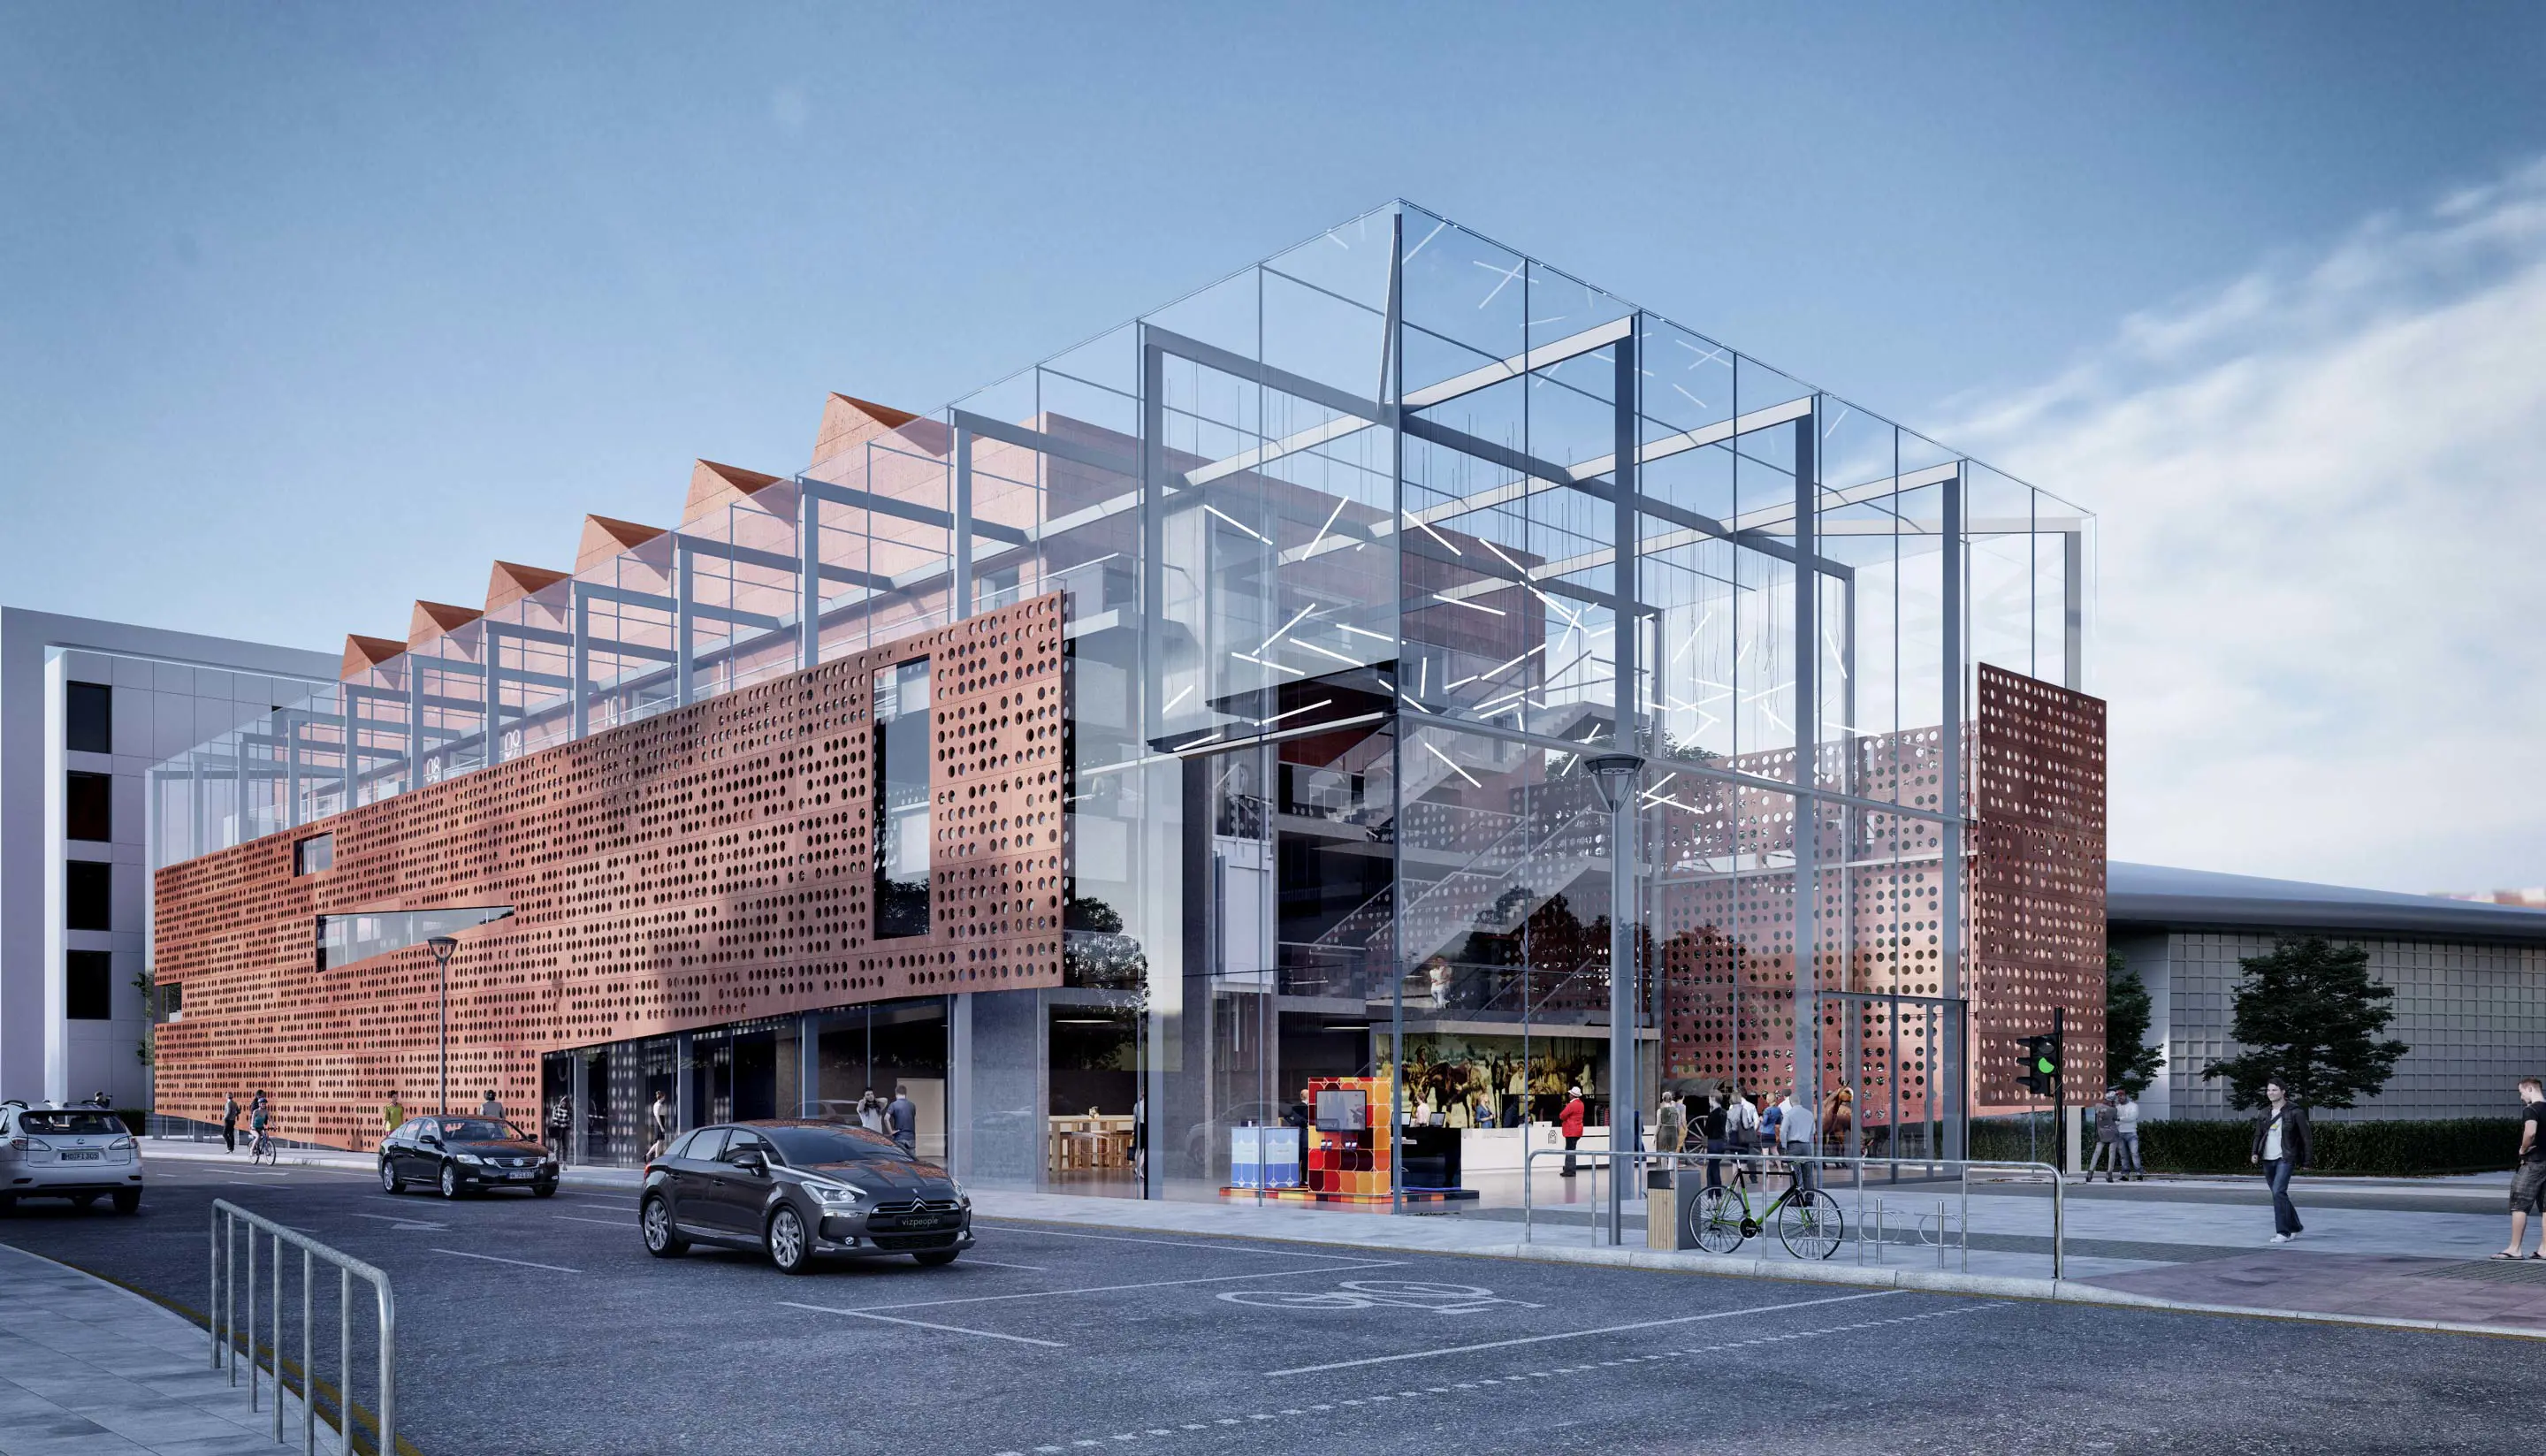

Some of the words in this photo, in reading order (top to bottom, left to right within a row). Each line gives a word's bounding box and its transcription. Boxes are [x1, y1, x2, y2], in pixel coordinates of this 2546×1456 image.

[505, 728, 521, 758] 09
[426, 756, 440, 783] 08
[902, 1216, 939, 1228] vizpeople
